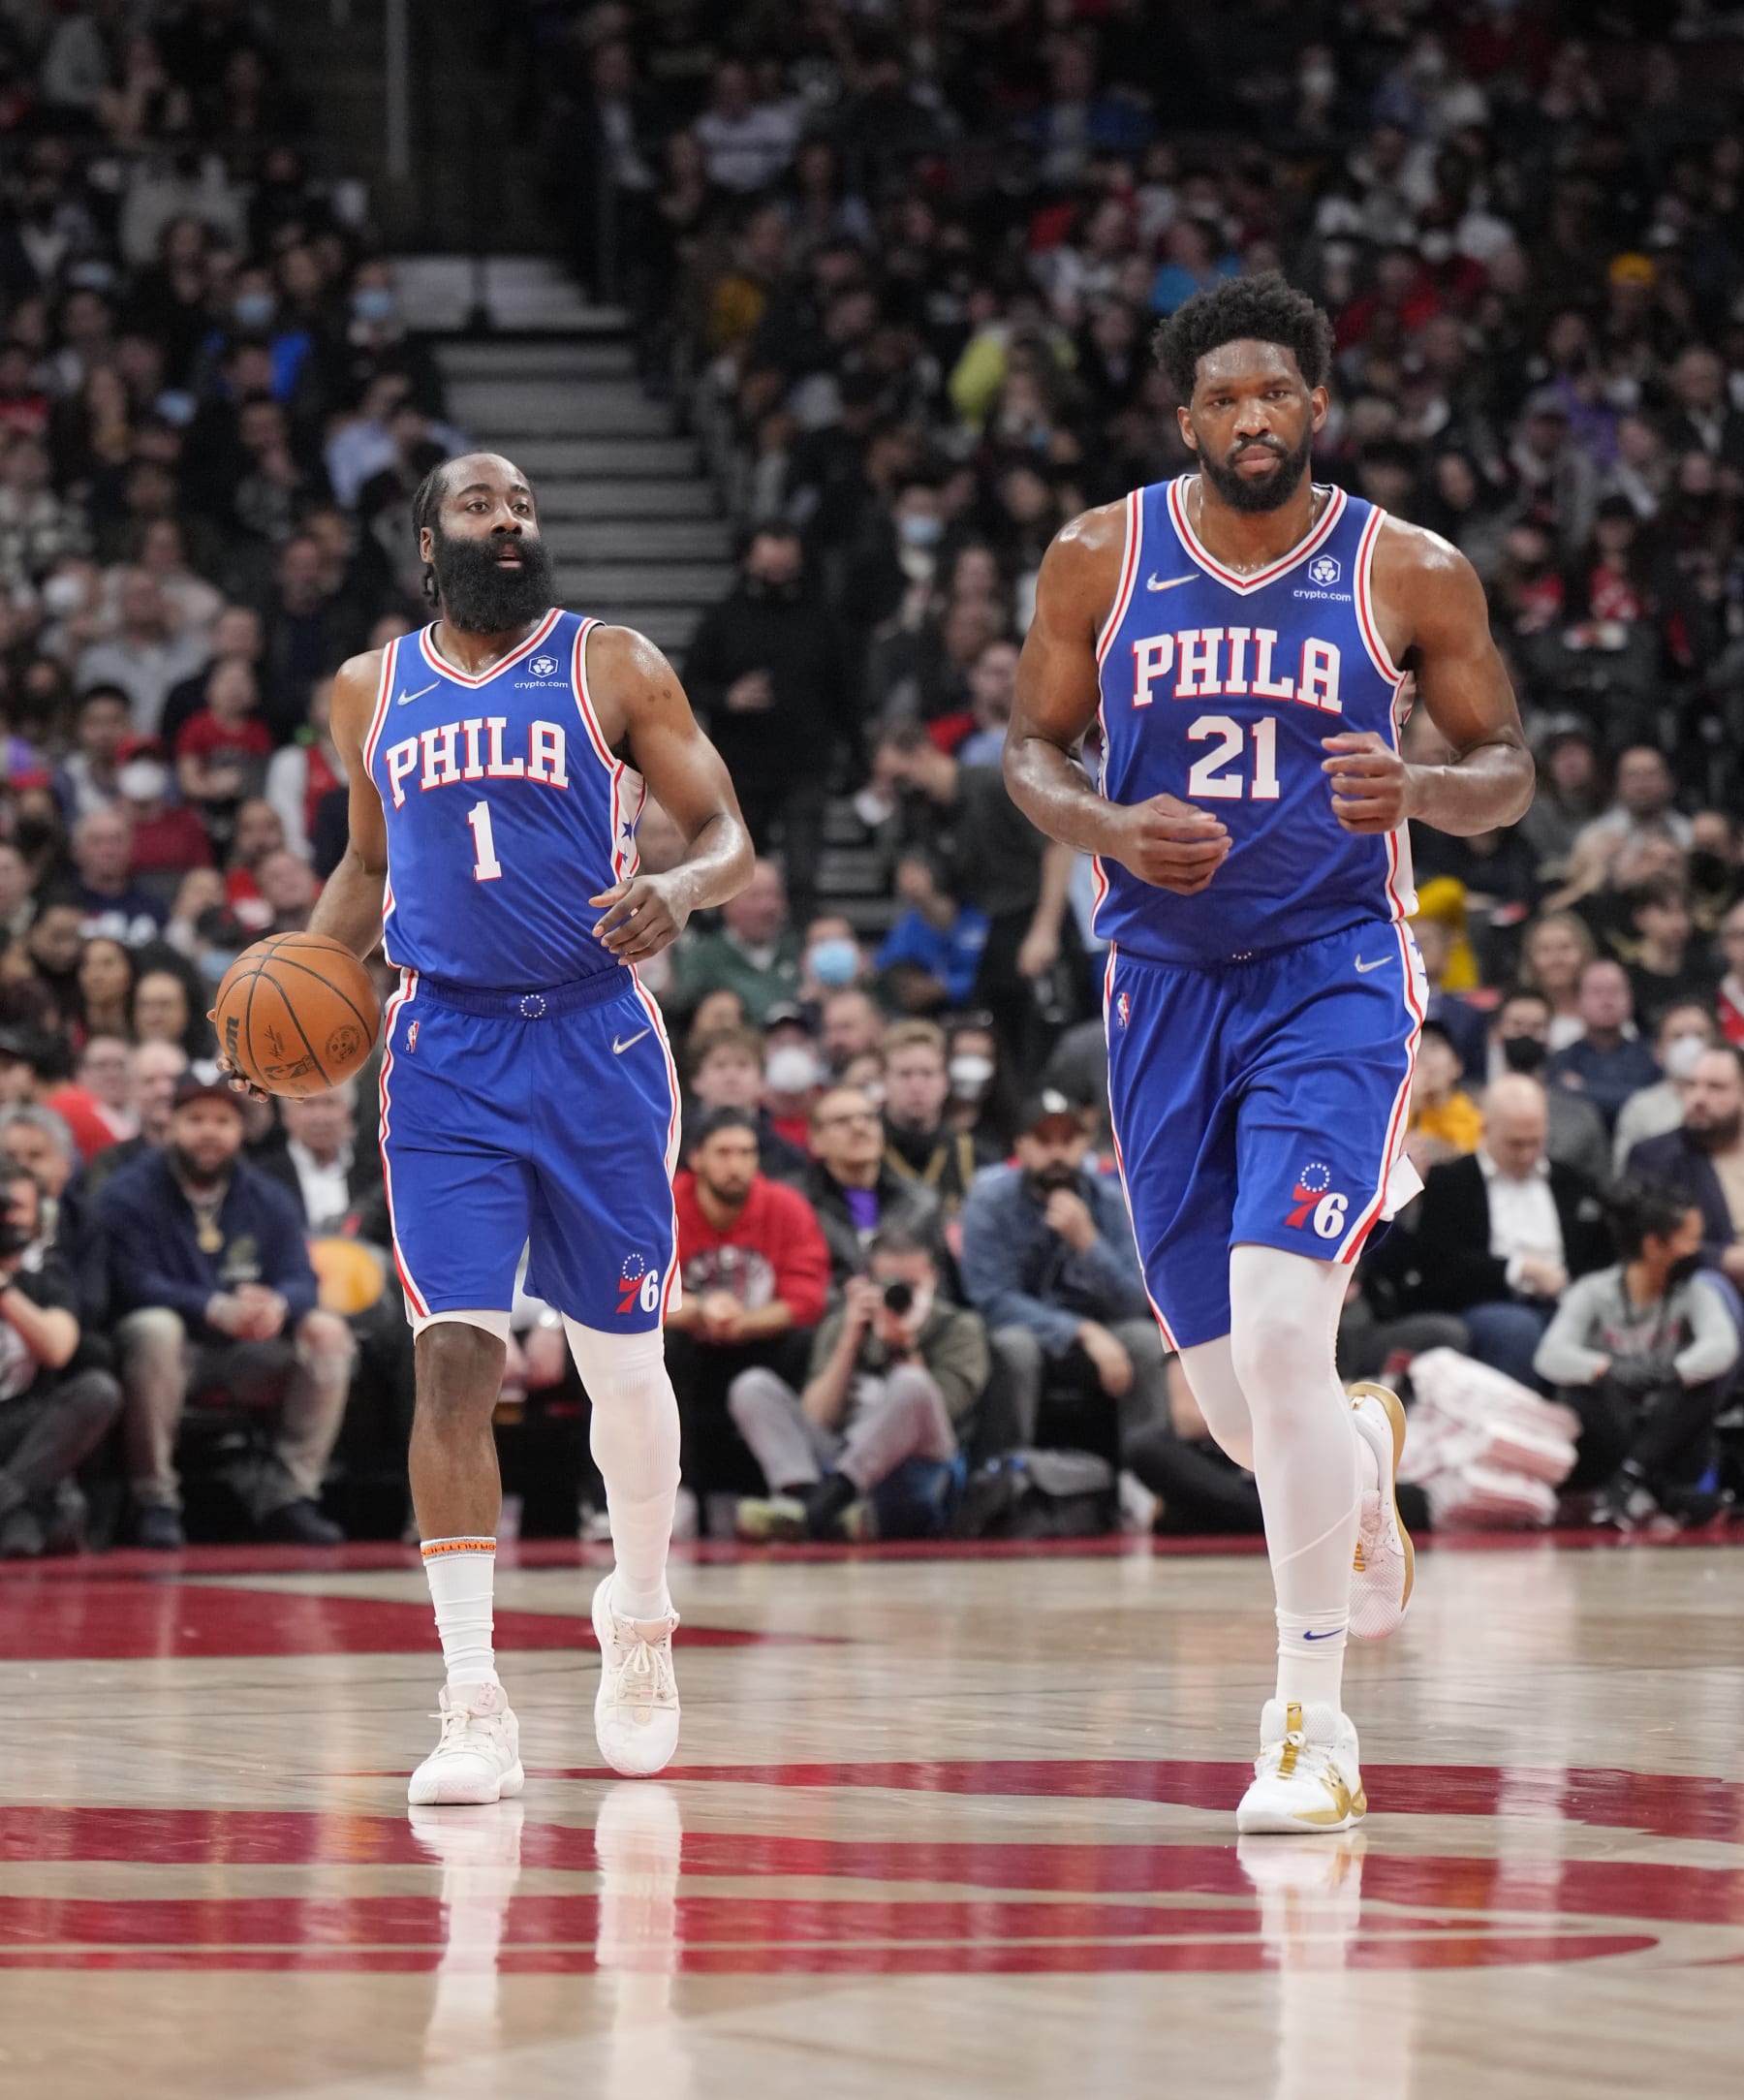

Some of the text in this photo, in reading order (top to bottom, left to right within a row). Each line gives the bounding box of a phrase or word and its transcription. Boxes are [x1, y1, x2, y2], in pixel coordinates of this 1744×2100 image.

[1292, 589, 1352, 602] crypto.com
[514, 680, 569, 689] crypto.com
[1131, 626, 1343, 715] PHILA
[384, 716, 569, 811] PHILA
[1186, 715, 1280, 799] 21
[466, 800, 502, 882] 1
[1284, 1181, 1349, 1238] 76
[616, 1269, 659, 1312] 76
